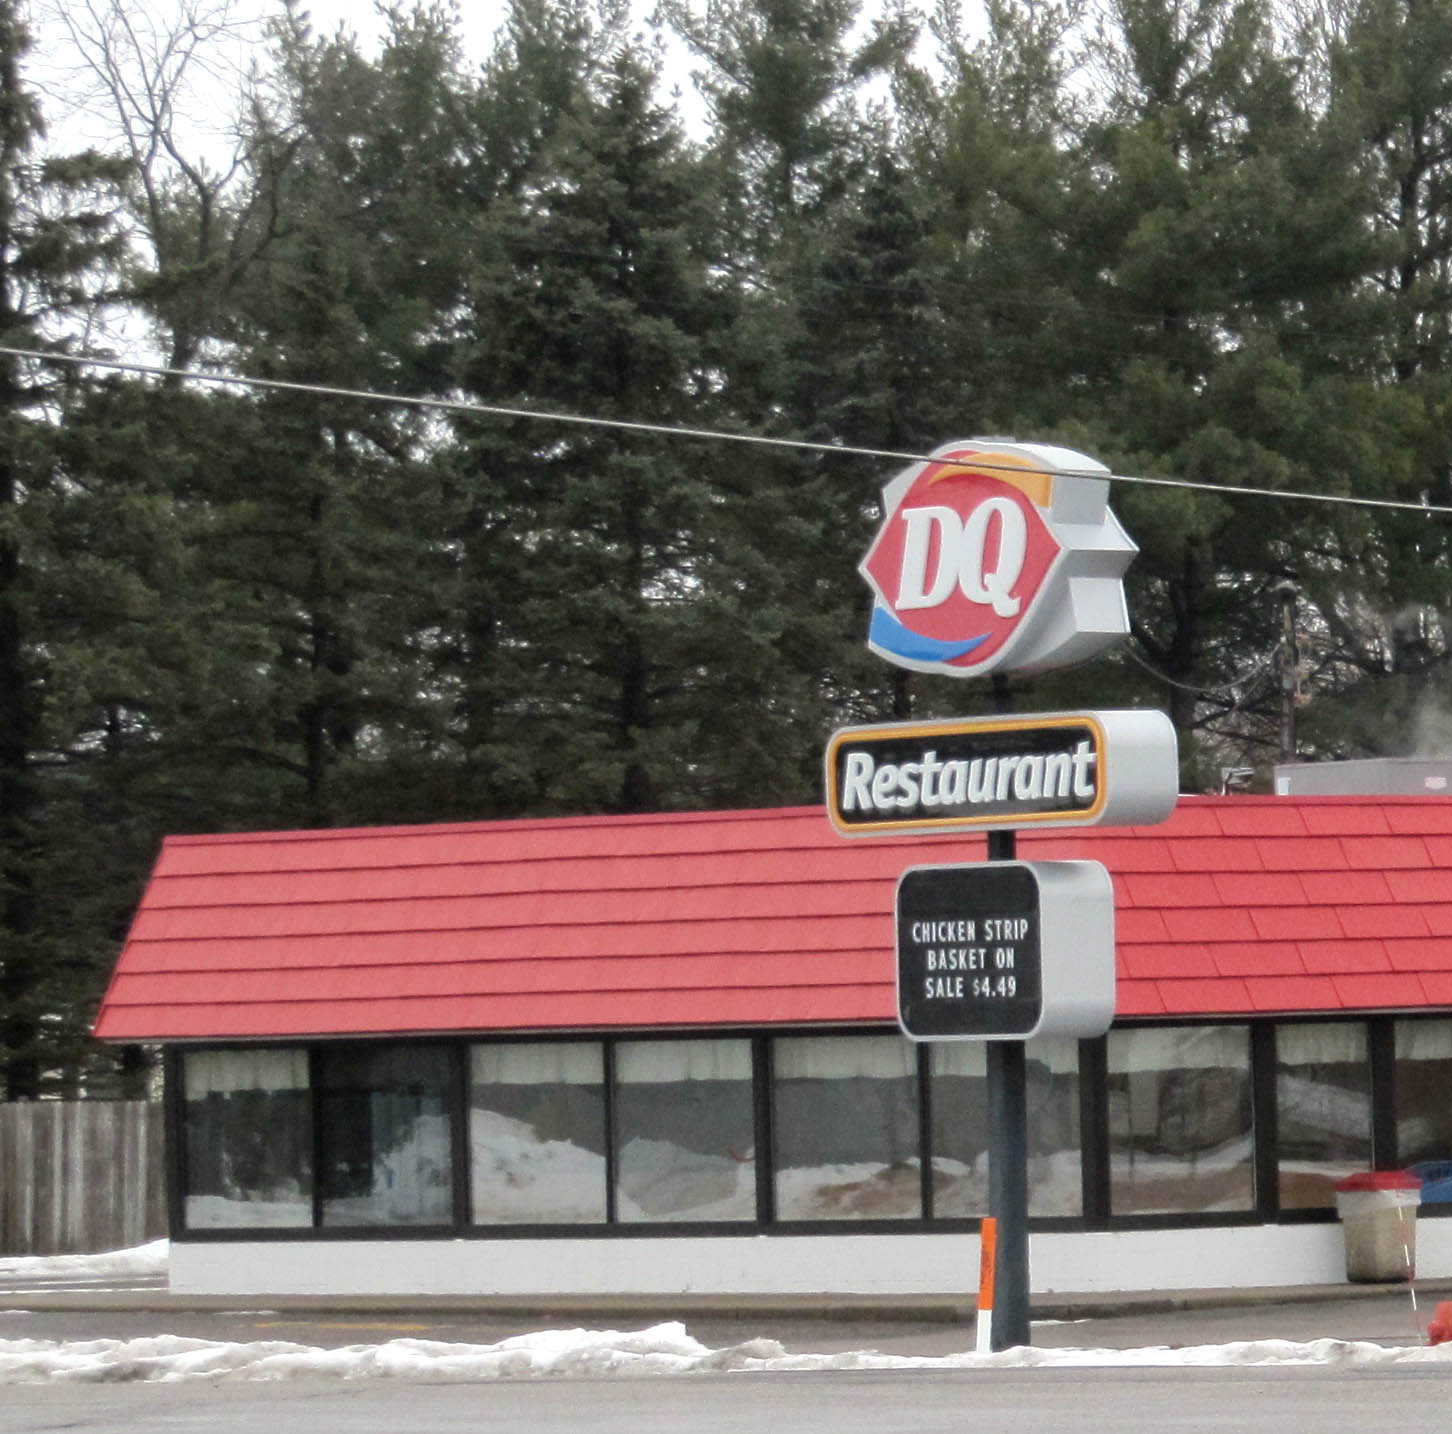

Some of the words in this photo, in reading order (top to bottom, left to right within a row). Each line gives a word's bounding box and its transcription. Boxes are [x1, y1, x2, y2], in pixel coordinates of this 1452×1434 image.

[894, 497, 1029, 618] DQ
[843, 740, 1098, 811] Restaurant
[912, 920, 976, 943] CHICKEN
[984, 918, 1029, 941] STRIP
[927, 948, 986, 971] BASKET
[996, 947, 1015, 969] ON
[925, 977, 964, 999] SALE
[972, 975, 1017, 997] $4.49
